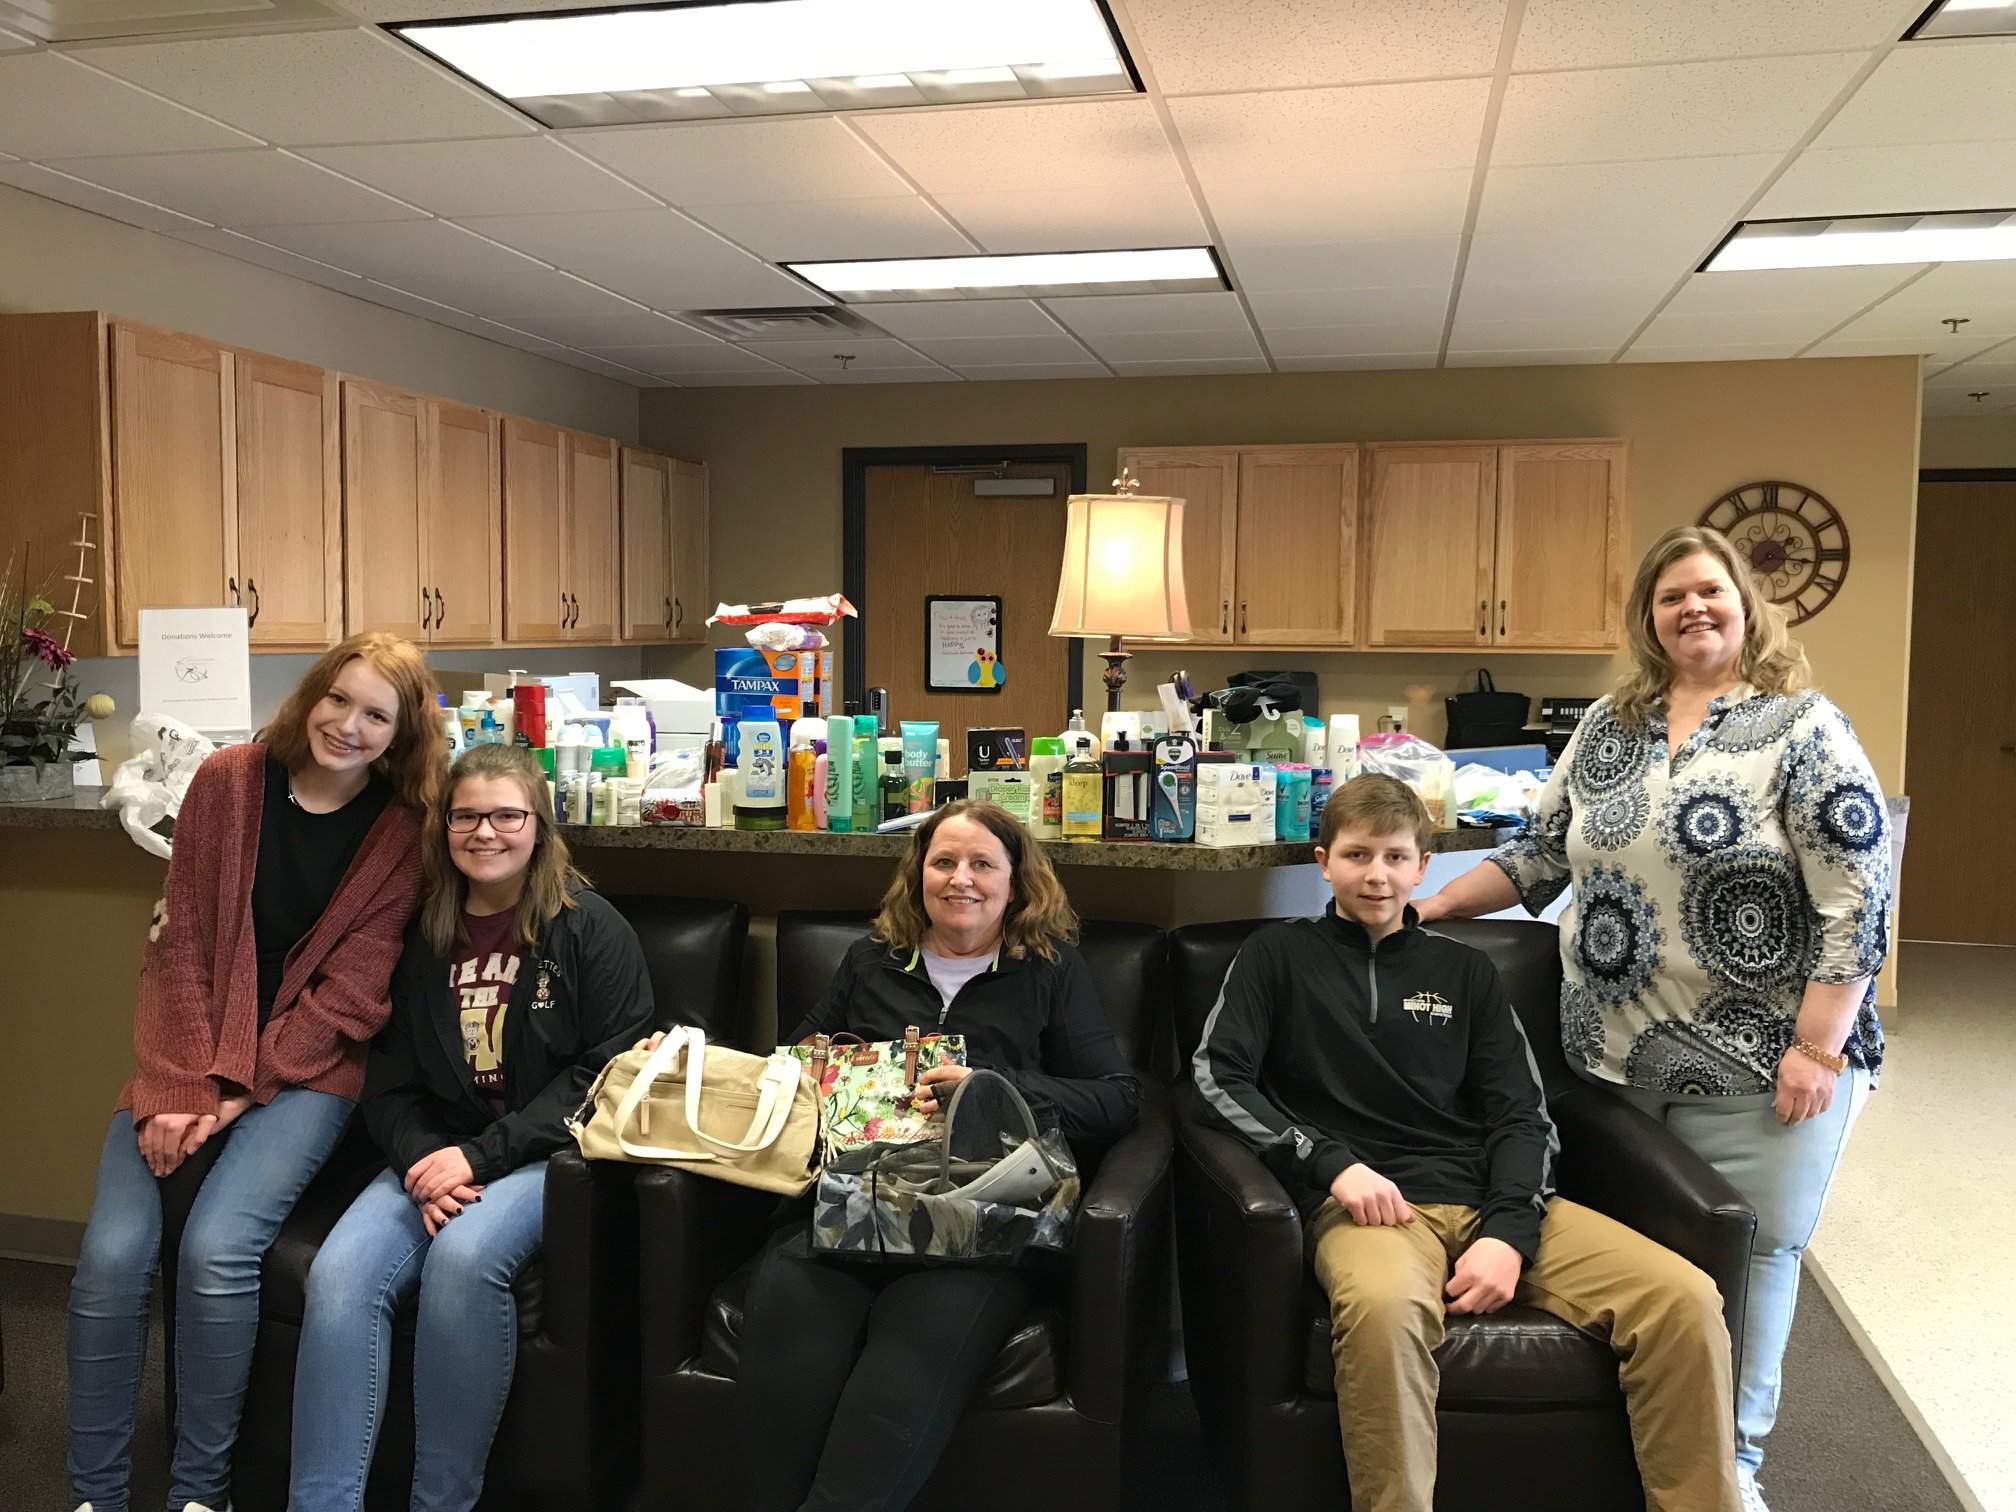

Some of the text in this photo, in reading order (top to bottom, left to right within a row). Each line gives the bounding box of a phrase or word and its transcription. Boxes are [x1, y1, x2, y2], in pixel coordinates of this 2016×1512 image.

[731, 679, 780, 692] TAMPAX
[905, 749, 928, 760] body
[905, 758, 933, 767] butter
[1230, 771, 1252, 781] Dove
[1068, 779, 1088, 788] sleep
[989, 784, 1030, 794] Diaper Ras
[1432, 1003, 1453, 1014] HIGH
